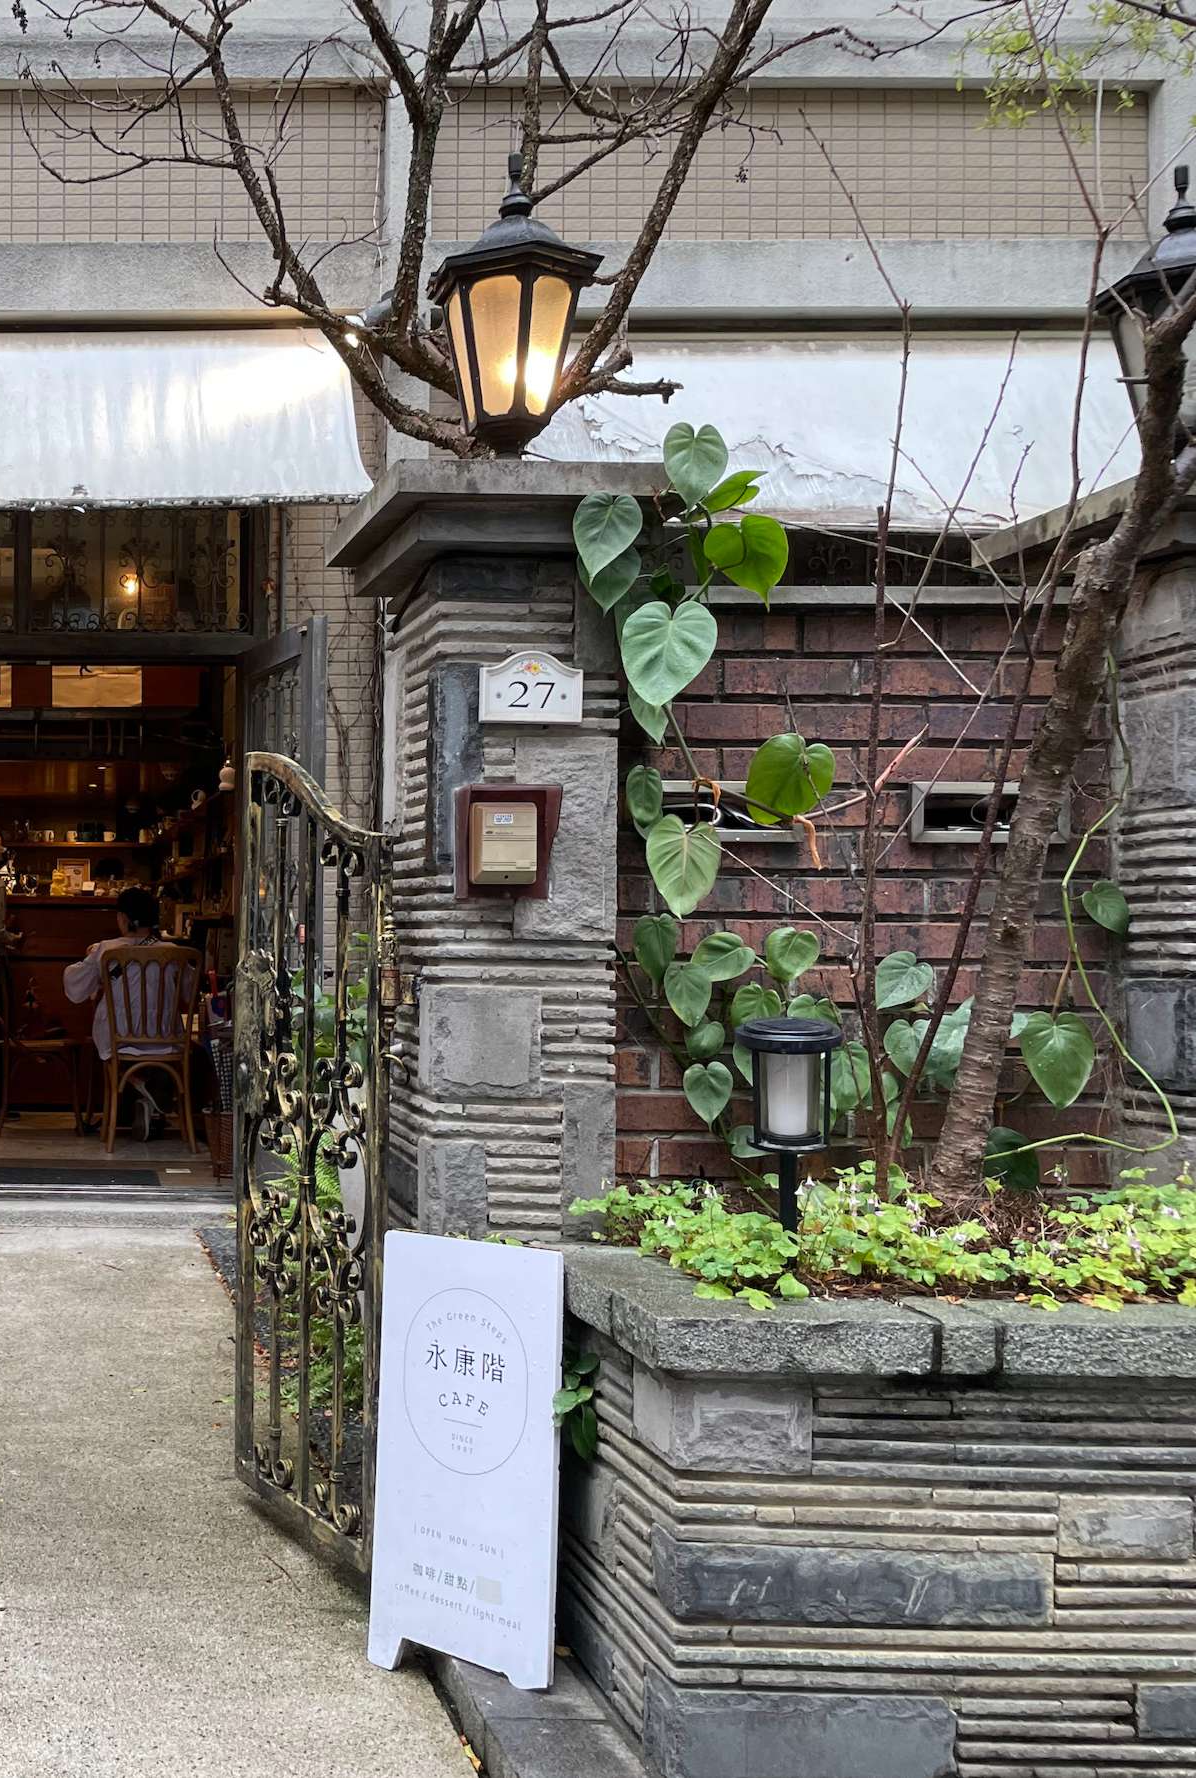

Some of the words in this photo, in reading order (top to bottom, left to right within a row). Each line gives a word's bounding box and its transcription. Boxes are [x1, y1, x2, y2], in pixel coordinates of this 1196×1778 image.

[507, 681, 555, 709] 27
[426, 1318, 442, 1332] The
[447, 1312, 476, 1321] Green
[480, 1318, 507, 1344] Steps
[425, 1339, 505, 1383] 永康階
[438, 1391, 489, 1416] CAFE
[420, 1526, 441, 1540] OPEN
[449, 1534, 468, 1546] MON
[479, 1543, 497, 1555] SUN
[394, 1583, 419, 1597] coffee
[429, 1593, 462, 1612] dessert
[472, 1606, 495, 1623] light
[498, 1616, 521, 1631] meal
